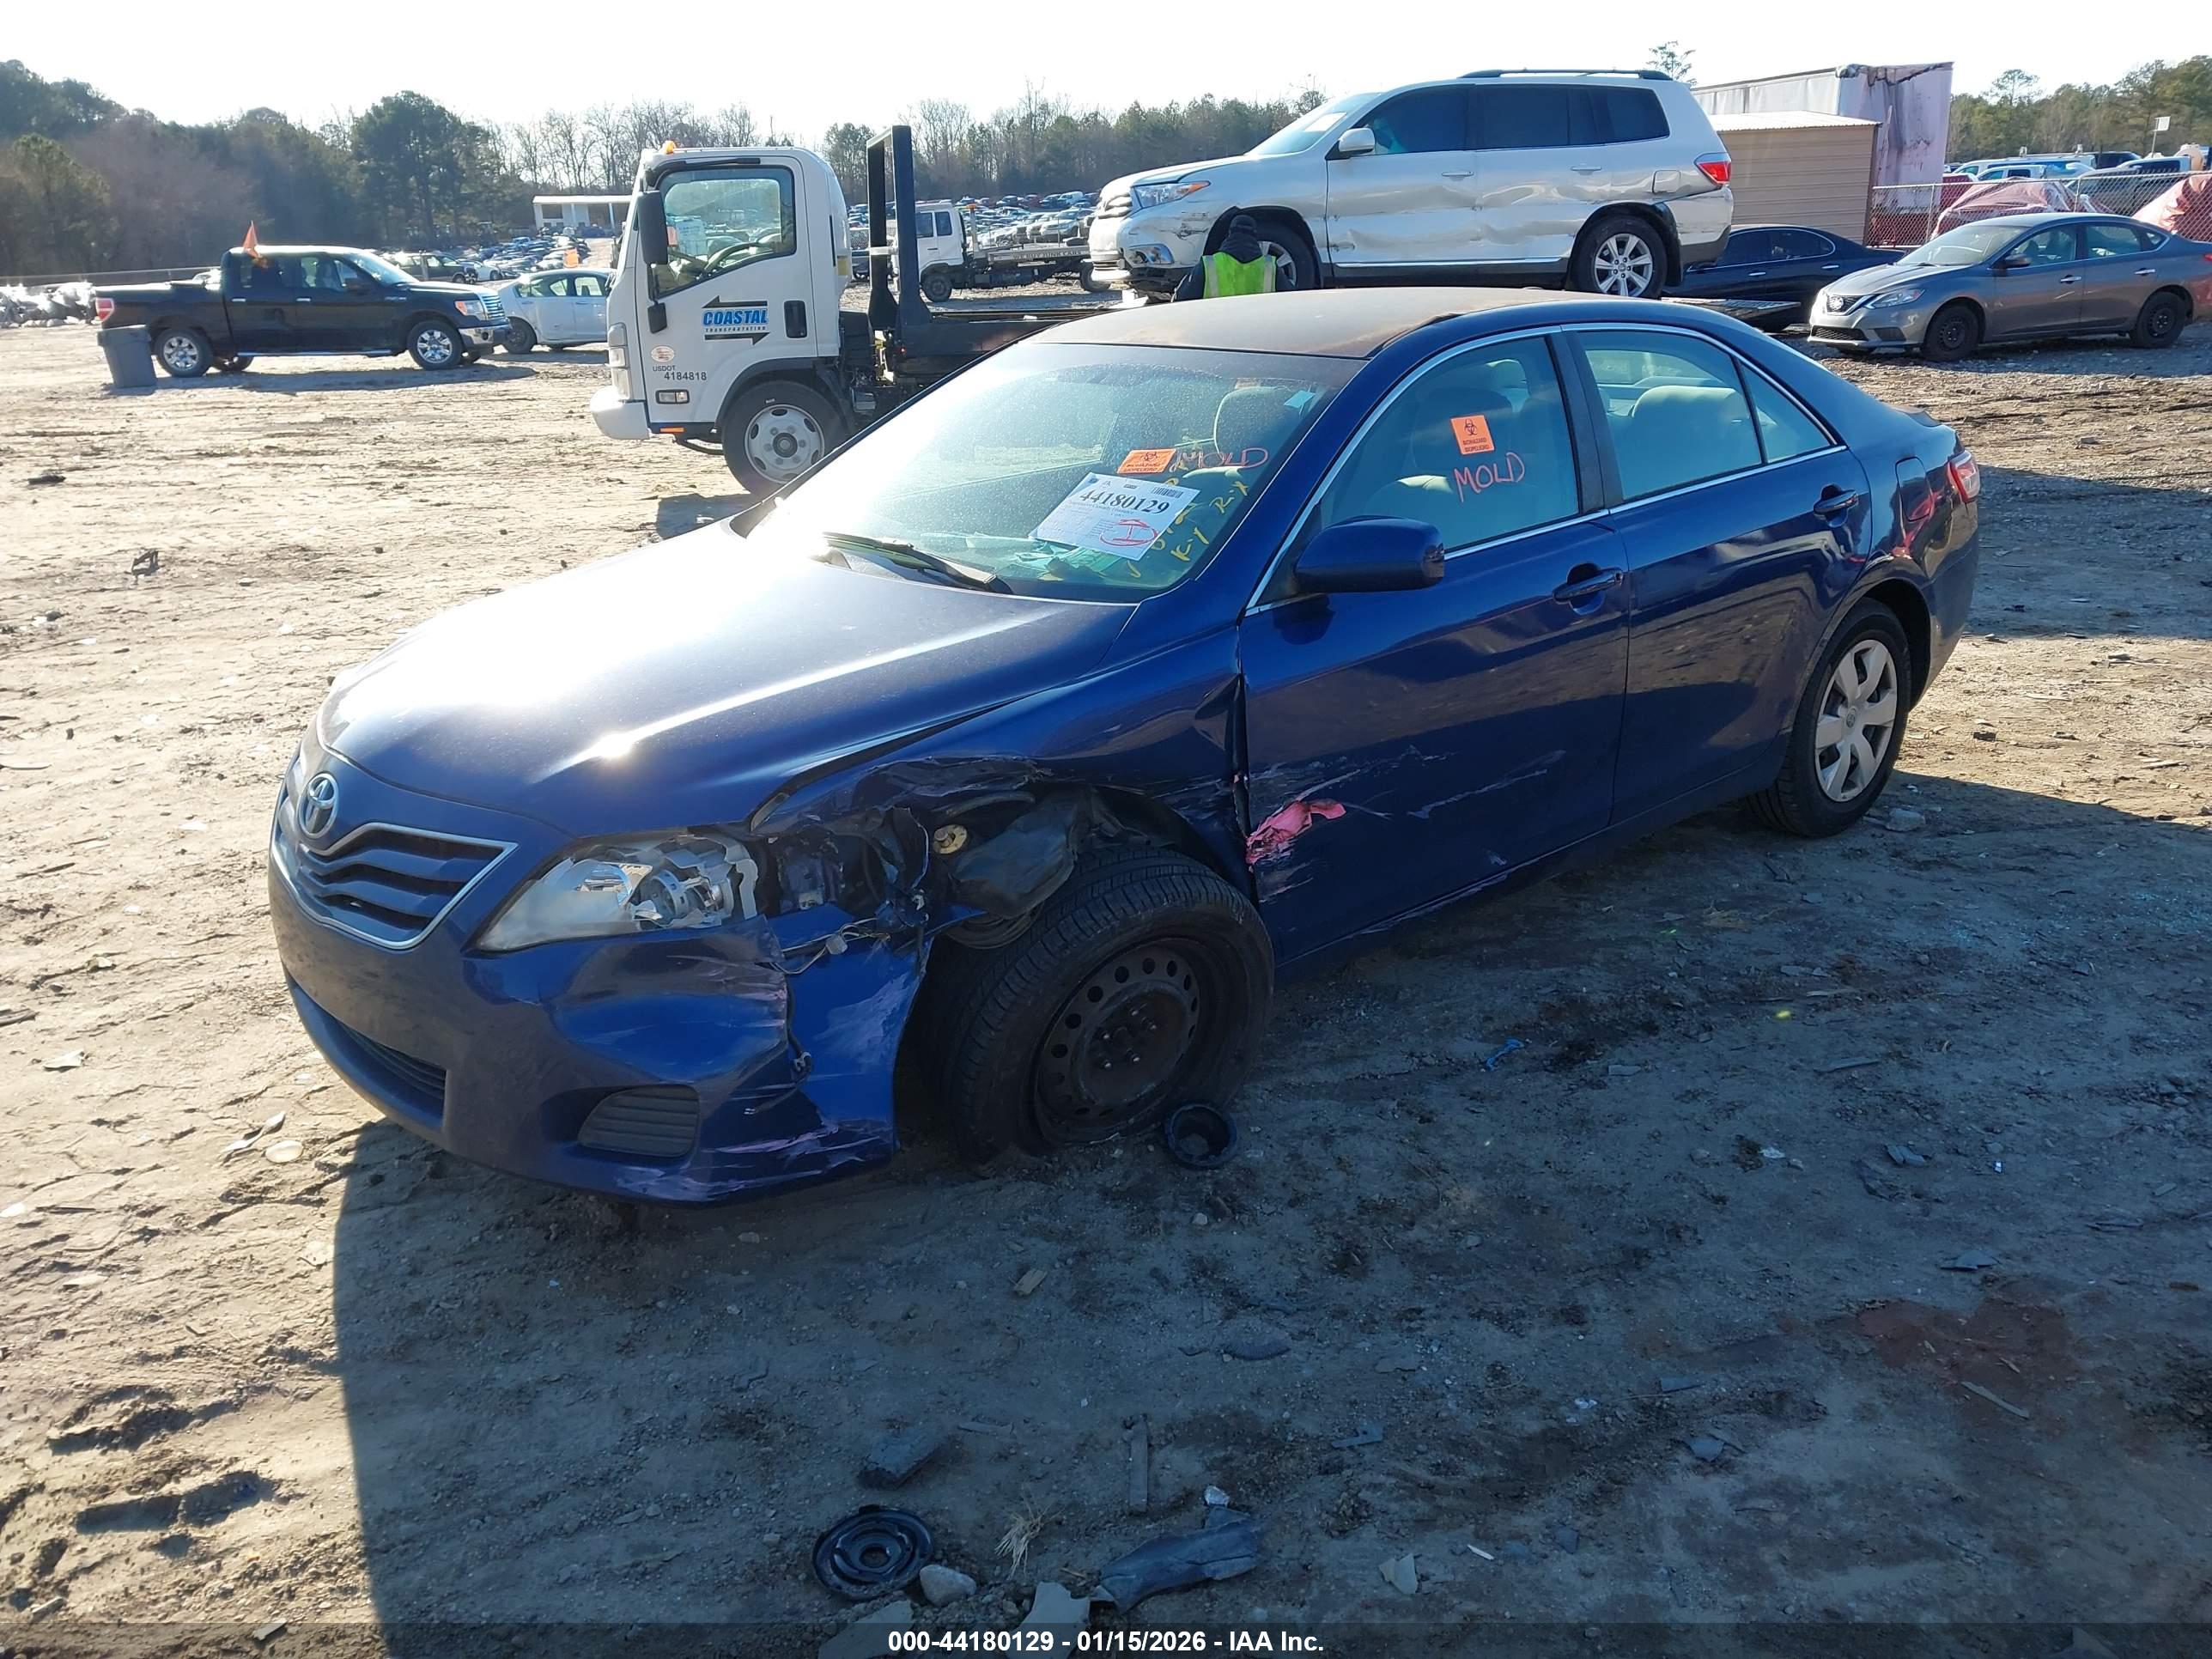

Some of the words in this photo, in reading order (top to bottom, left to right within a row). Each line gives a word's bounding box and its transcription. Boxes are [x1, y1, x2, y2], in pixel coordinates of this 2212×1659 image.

[702, 309, 768, 325] COASTAL
[664, 371, 708, 380] 4184818
[1170, 447, 1268, 472] MOLD
[1454, 452, 1525, 503] MOLD
[1079, 489, 1170, 514] 44180129
